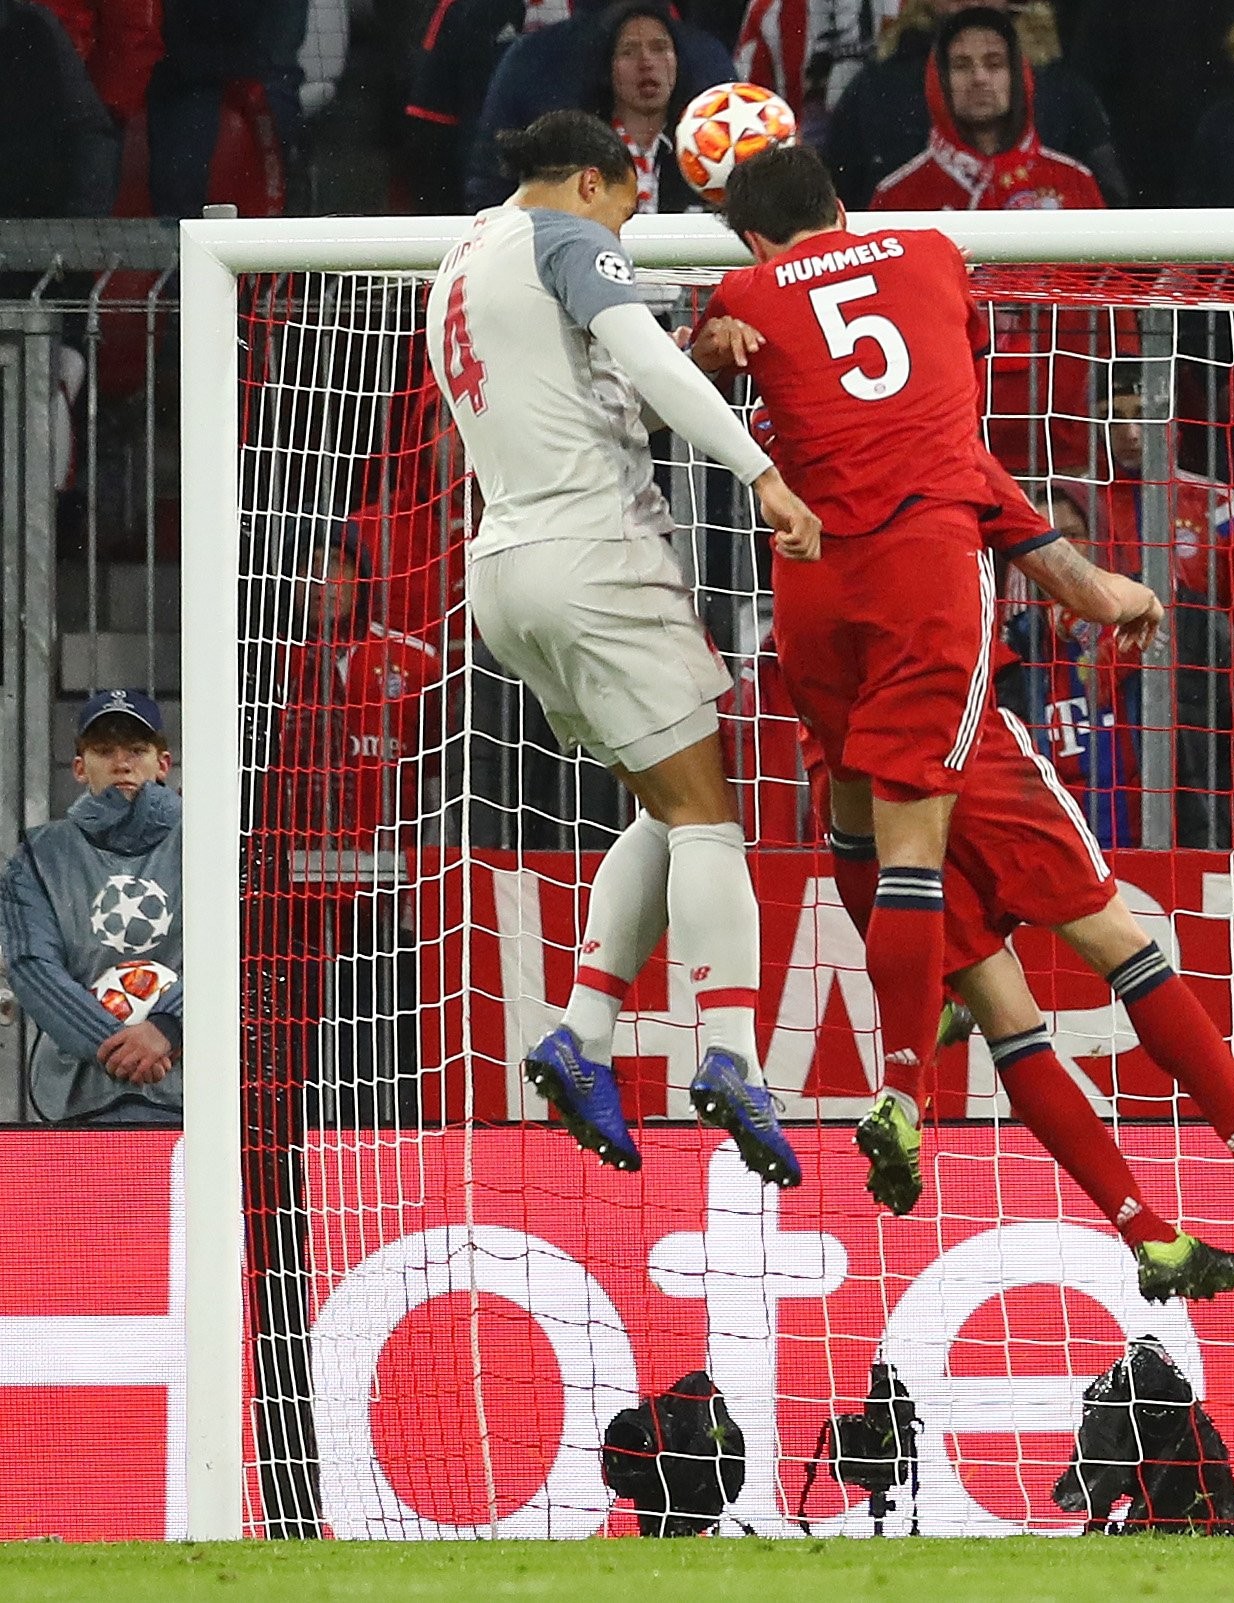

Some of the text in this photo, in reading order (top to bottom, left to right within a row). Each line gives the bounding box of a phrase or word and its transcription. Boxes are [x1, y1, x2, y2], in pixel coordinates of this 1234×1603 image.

[775, 237, 905, 288] HUMMELS
[443, 274, 488, 417] 4
[808, 274, 912, 402] 5
